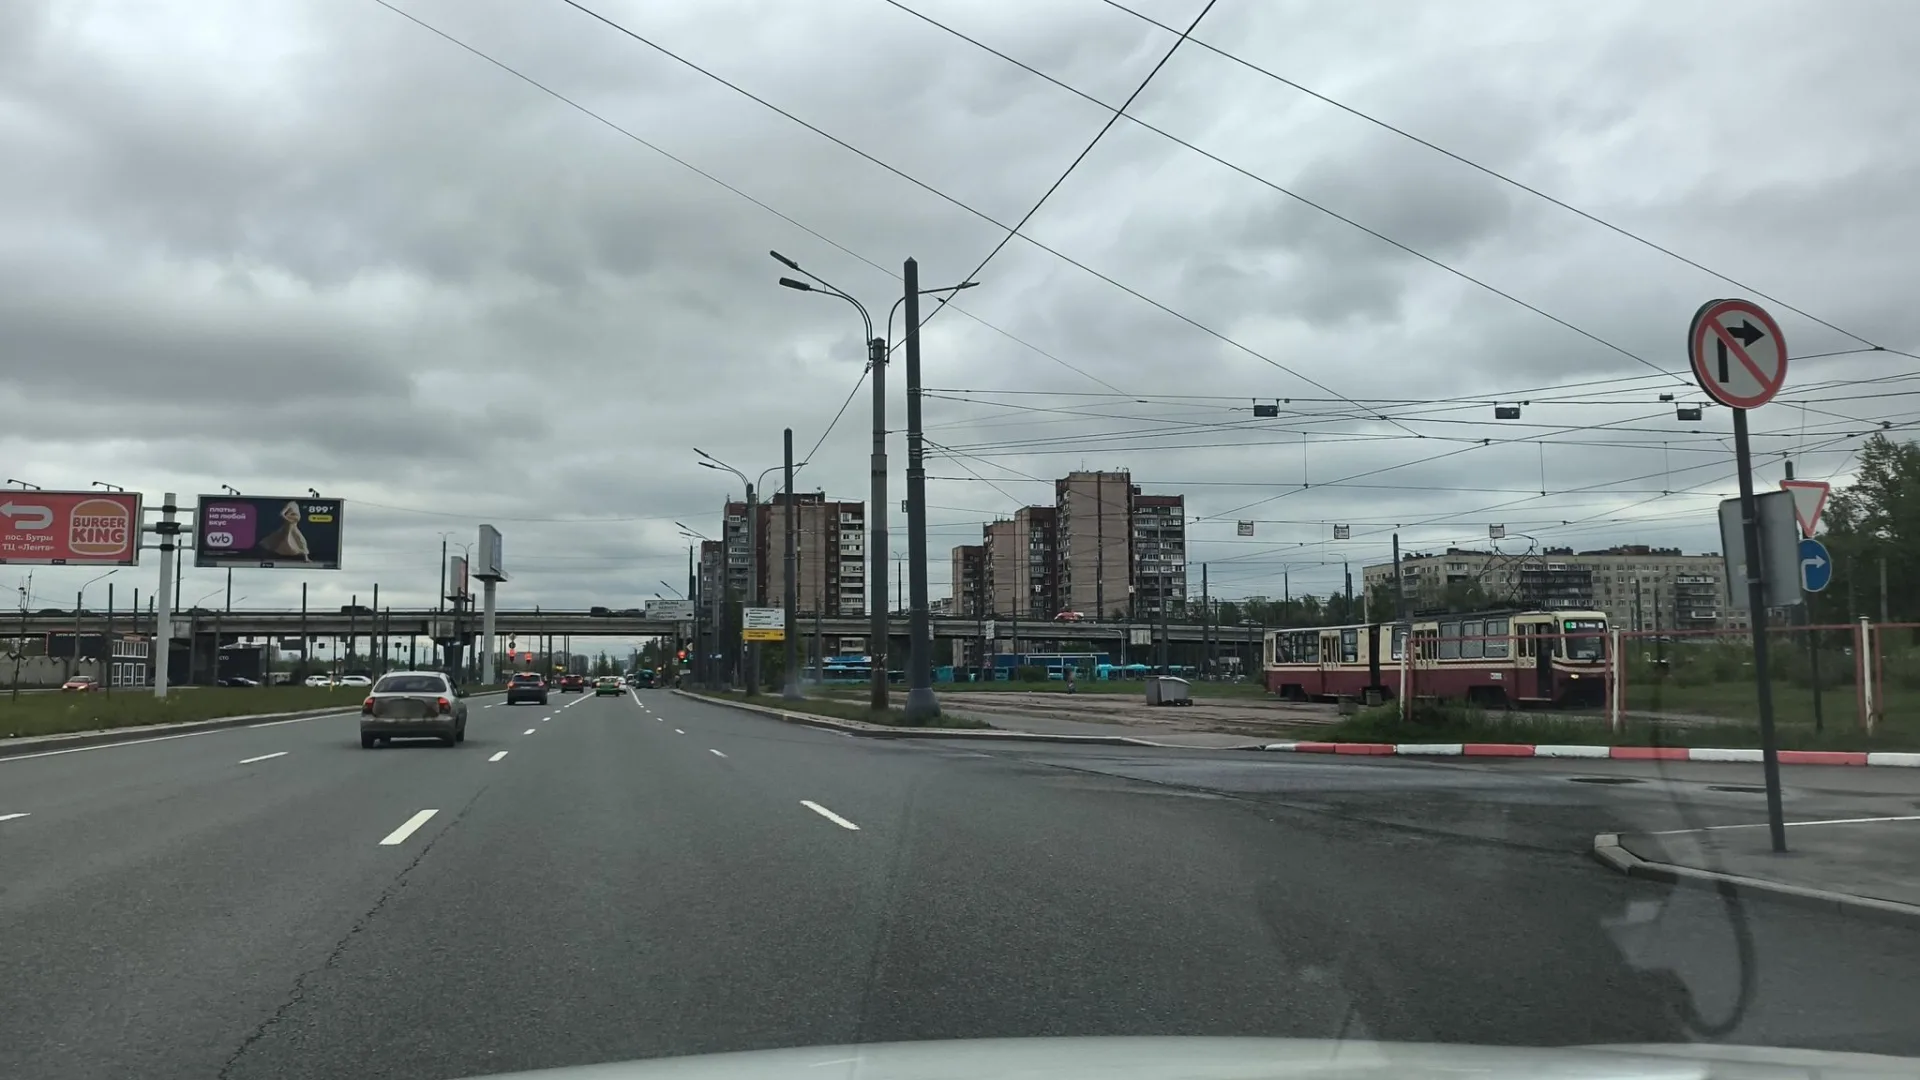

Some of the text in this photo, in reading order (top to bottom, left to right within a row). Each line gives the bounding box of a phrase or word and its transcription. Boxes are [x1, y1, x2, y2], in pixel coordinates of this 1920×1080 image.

[73, 517, 125, 527] BURGER
[26, 533, 54, 542] Бугры
[72, 528, 125, 542] KING
[210, 533, 230, 544] wb
[2, 543, 16, 551] ТЦ
